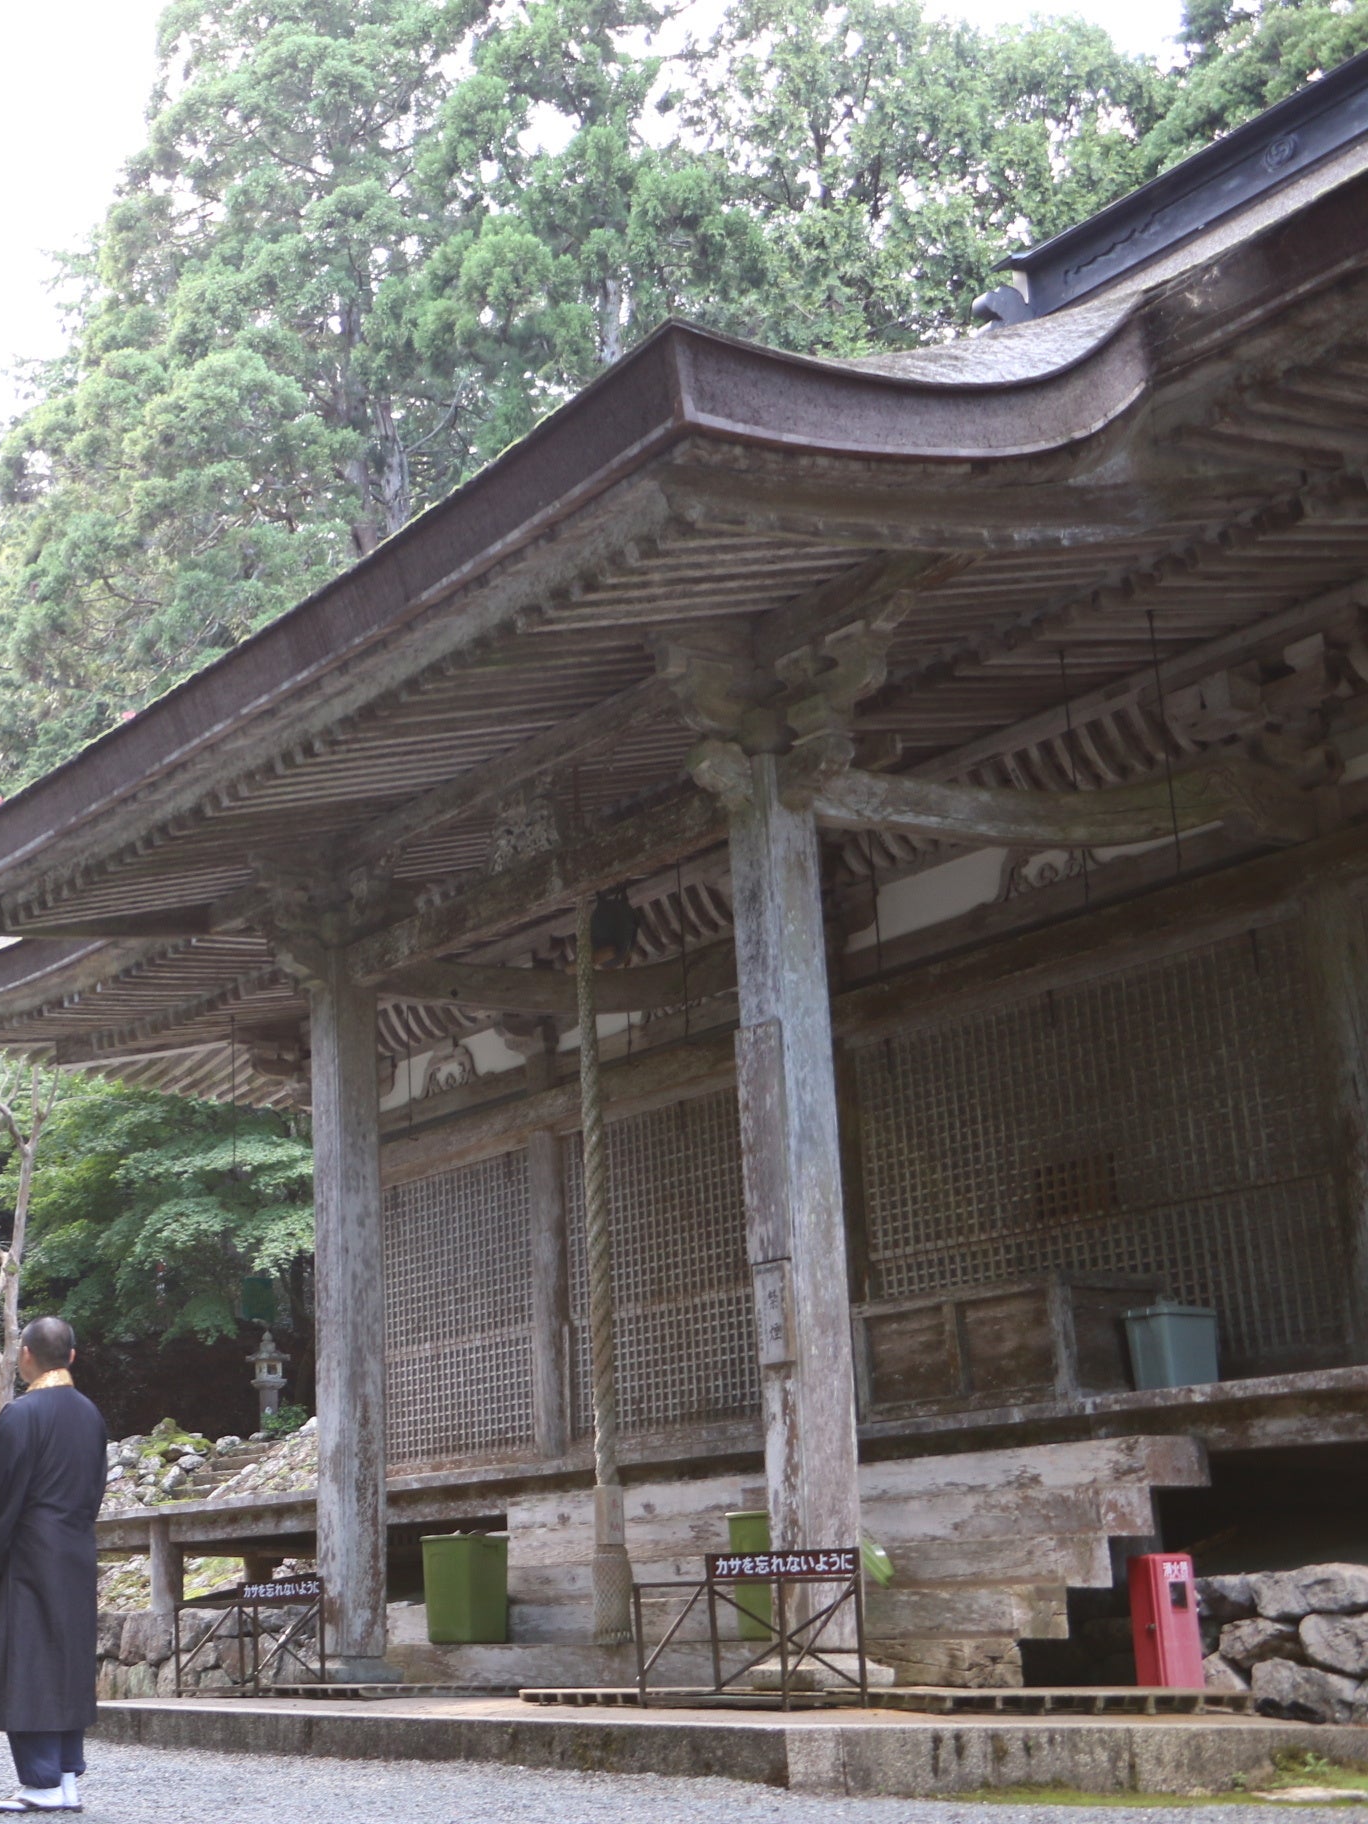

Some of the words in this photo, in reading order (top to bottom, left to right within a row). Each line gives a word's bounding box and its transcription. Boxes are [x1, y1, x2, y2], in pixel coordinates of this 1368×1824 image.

[715, 1553, 854, 1575] カサを忘れないように
[243, 1580, 320, 1598] カサを忘れないように
